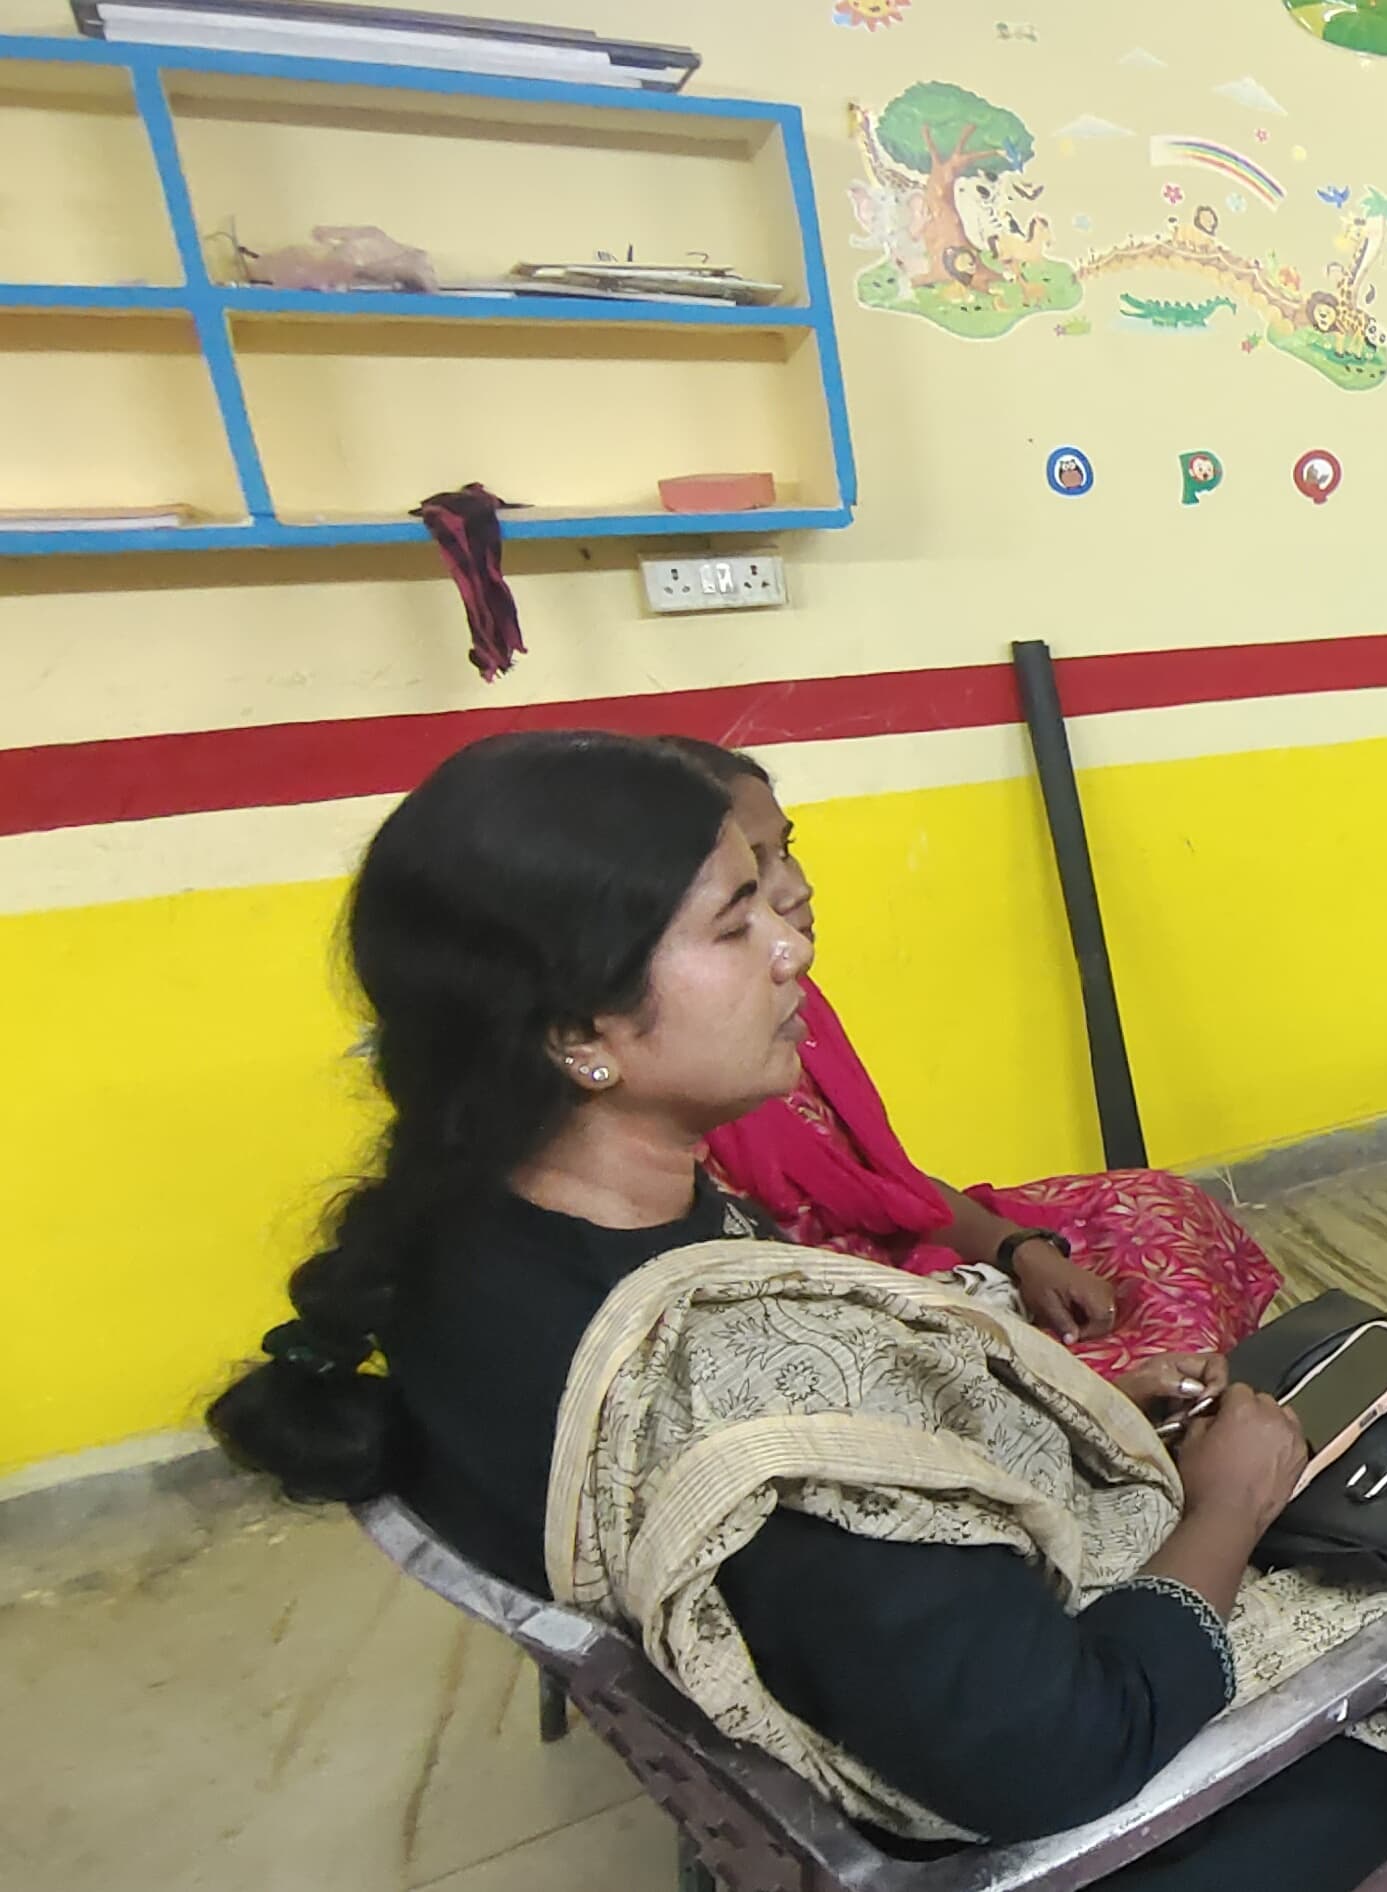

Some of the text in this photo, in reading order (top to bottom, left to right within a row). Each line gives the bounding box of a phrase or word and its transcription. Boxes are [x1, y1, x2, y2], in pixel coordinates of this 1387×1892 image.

[1046, 447, 1094, 496] O
[1179, 451, 1223, 505] P
[1293, 449, 1341, 505] Q
